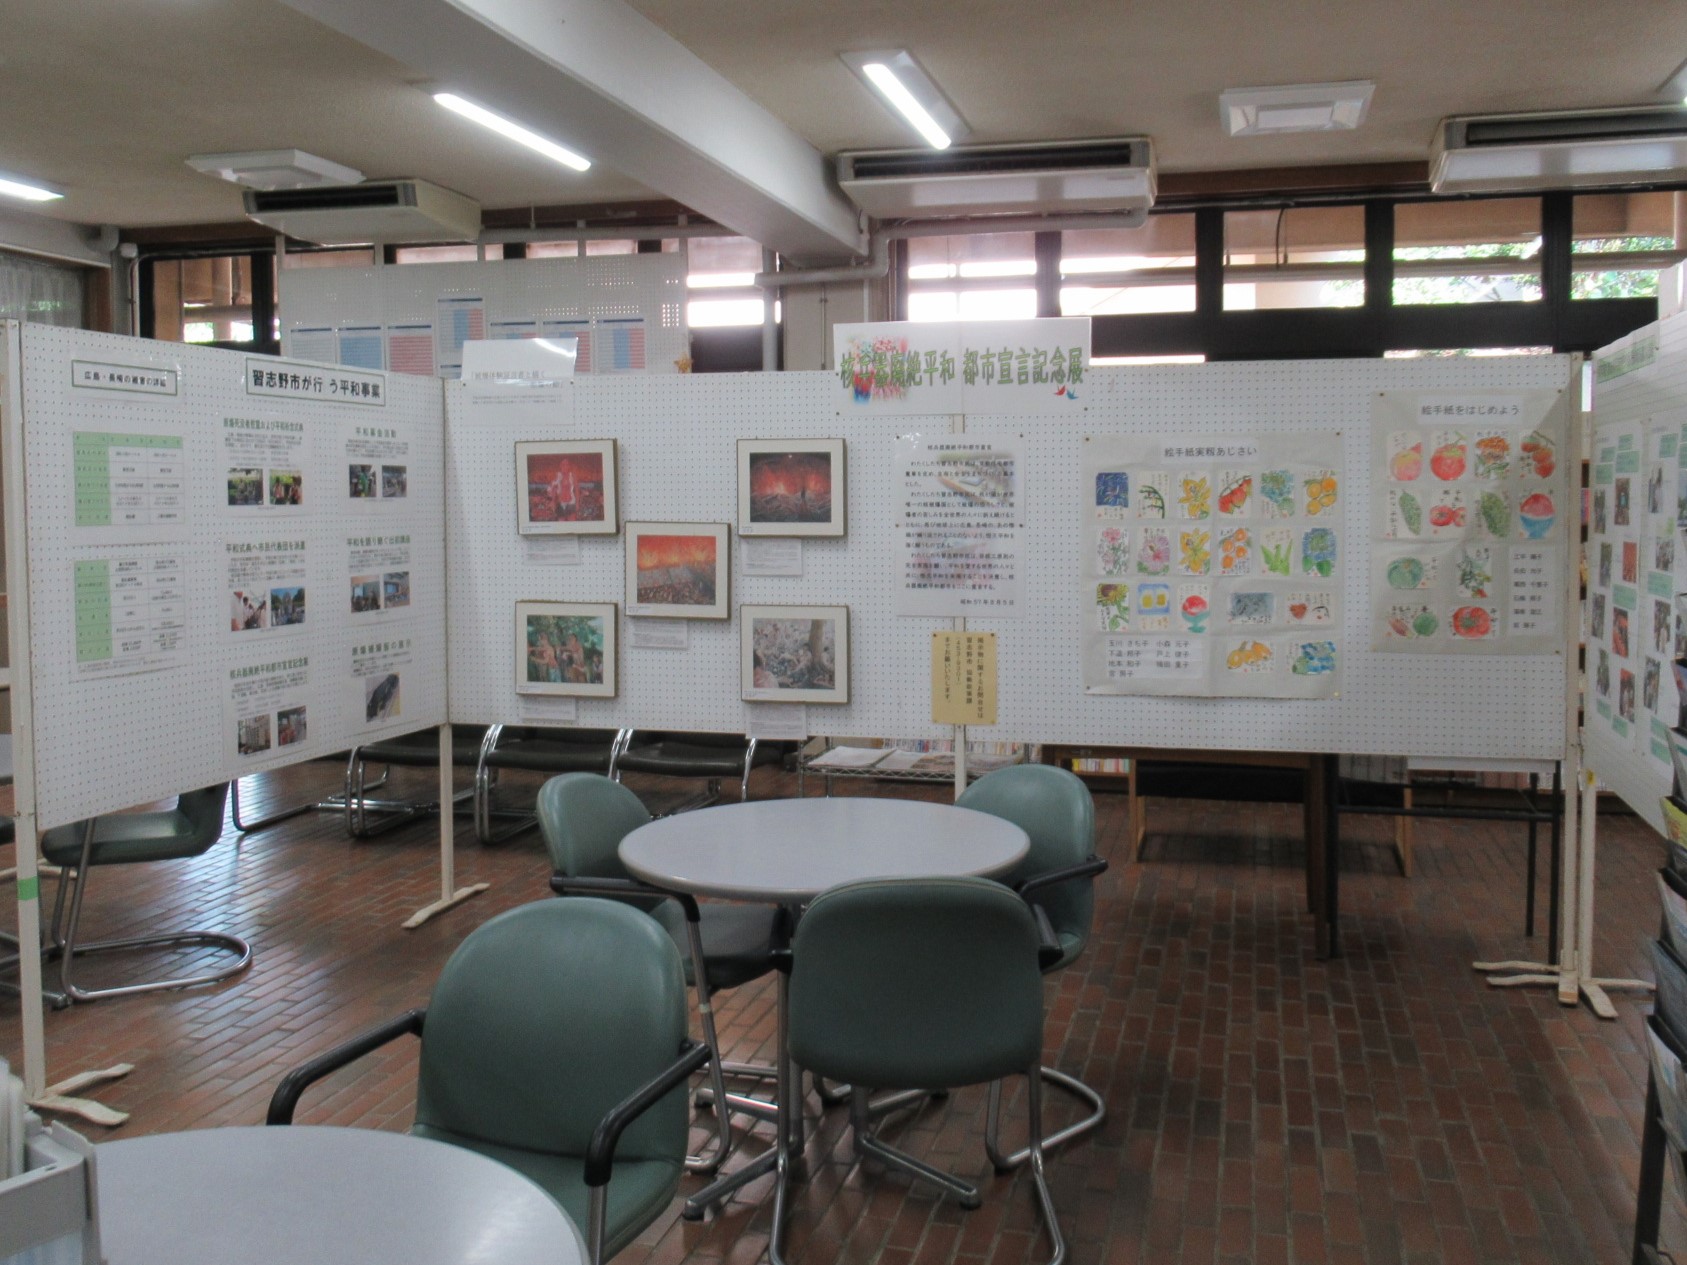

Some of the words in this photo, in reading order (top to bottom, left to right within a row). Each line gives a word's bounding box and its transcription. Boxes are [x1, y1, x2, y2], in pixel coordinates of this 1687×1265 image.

[252, 369, 381, 399] 習志野市が行う平和事業
[1421, 404, 1520, 415] 絵手紙をはじめよう
[1164, 447, 1257, 457] 絵手紙実籾あじさい
